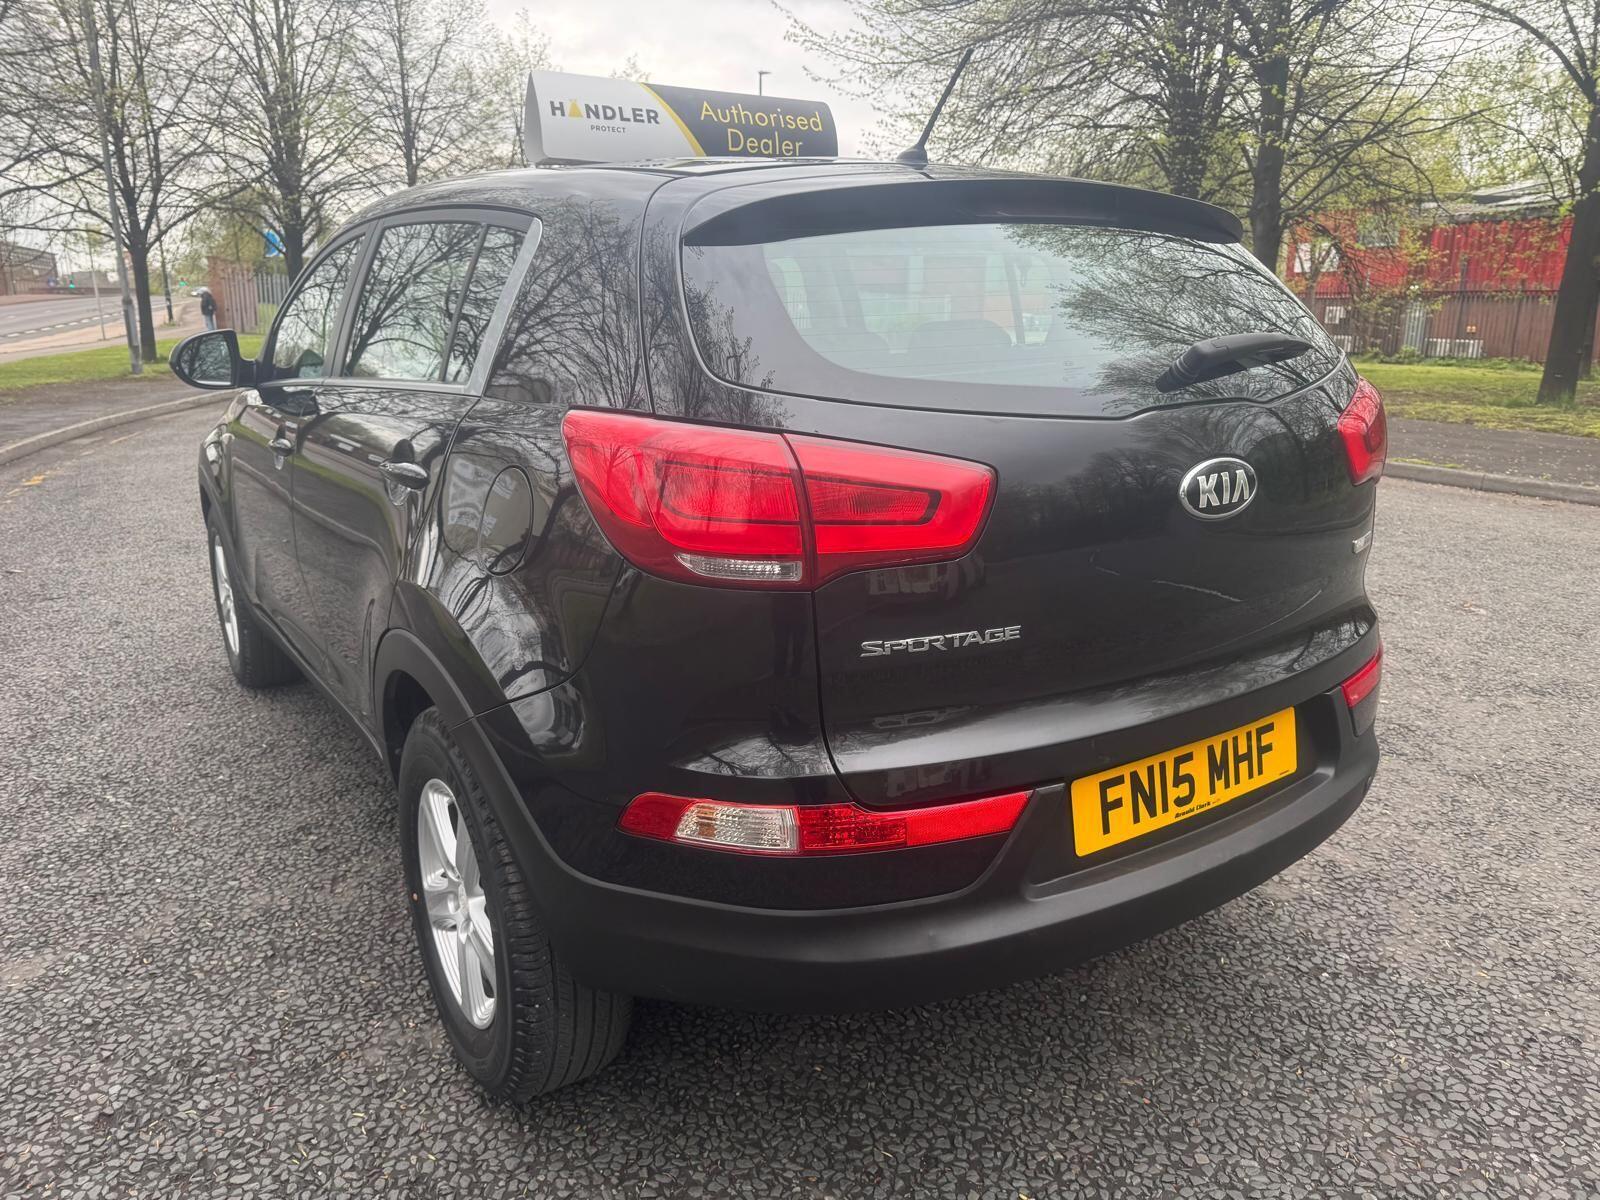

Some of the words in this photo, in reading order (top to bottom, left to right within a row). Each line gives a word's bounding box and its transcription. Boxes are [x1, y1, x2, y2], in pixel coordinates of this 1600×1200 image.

[549, 99, 660, 125] HANDLER
[700, 100, 823, 132] Authorised
[590, 124, 626, 133] PROTECT
[727, 128, 803, 157] Dealer
[1197, 469, 1250, 509] KIA
[860, 625, 1021, 658] SPORTAGE
[1099, 751, 1196, 836] FN15
[1207, 722, 1275, 796] MHF
